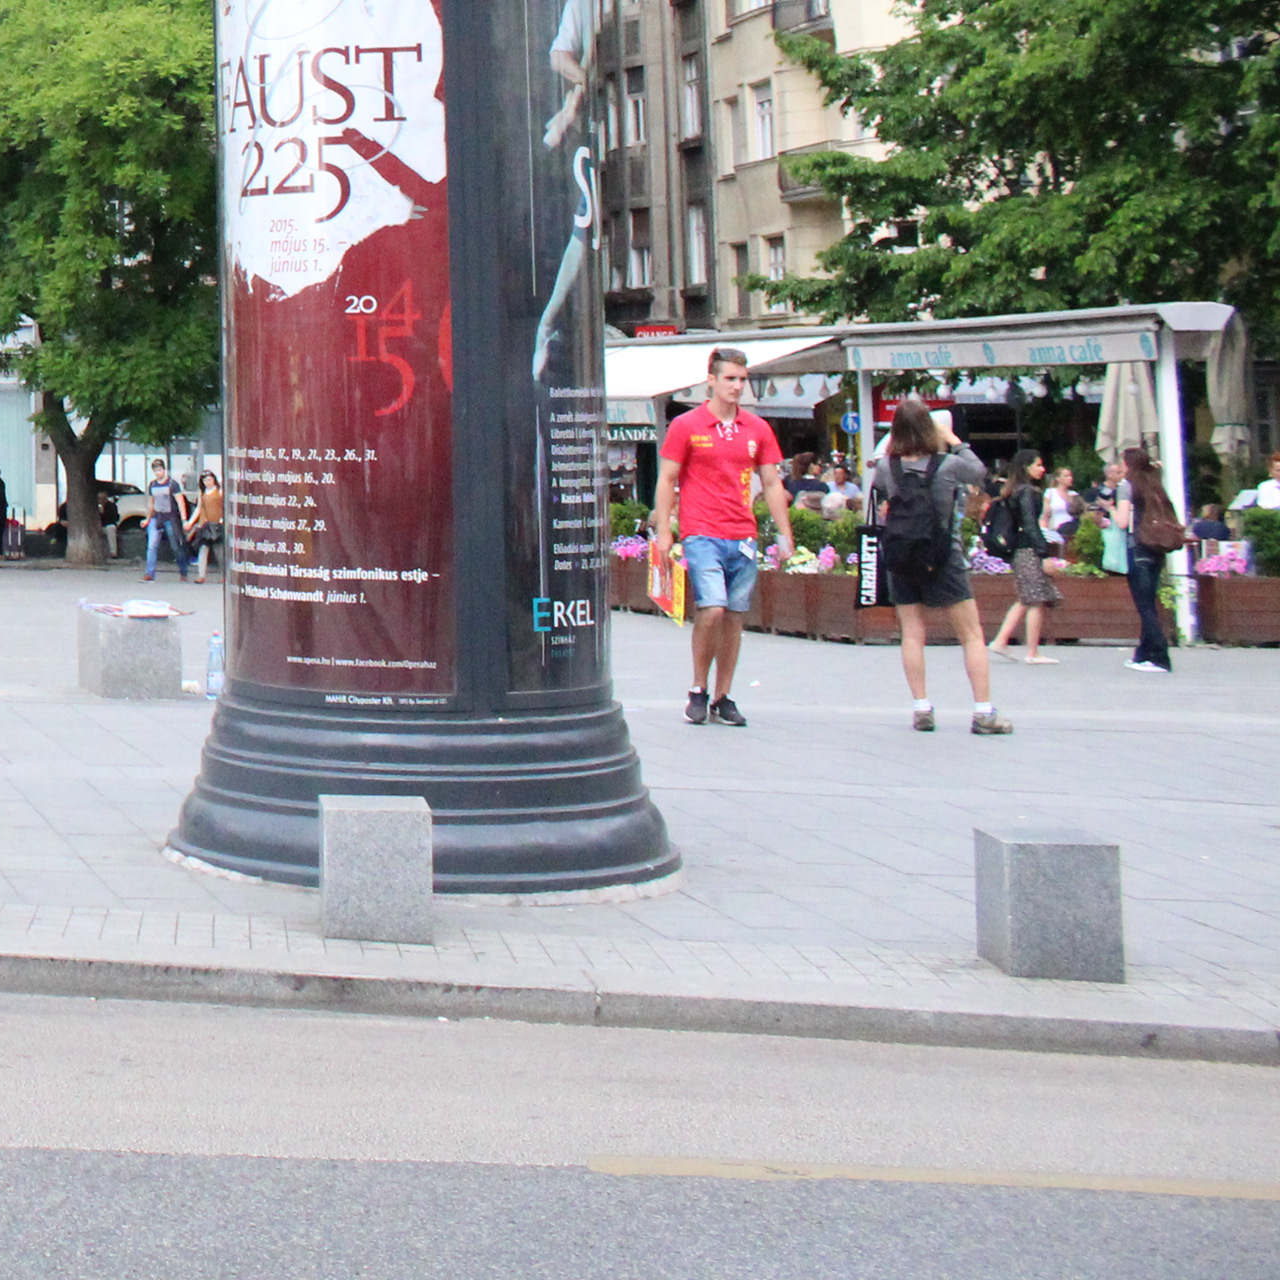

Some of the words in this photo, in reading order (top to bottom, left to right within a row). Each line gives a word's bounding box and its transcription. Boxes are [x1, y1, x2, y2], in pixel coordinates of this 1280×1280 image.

[220, 43, 423, 136] FAUST
[241, 136, 351, 224] 225
[269, 219, 298, 233] 2015.
[270, 236, 308, 253] május
[313, 238, 330, 253] 15.
[269, 256, 308, 276] június
[314, 259, 322, 272] 1.
[889, 350, 922, 368] anna
[925, 343, 954, 368] café
[1028, 345, 1066, 364] anna
[1069, 336, 1104, 363] café
[321, 473, 336, 484] 20.
[289, 564, 330, 581] Társaság
[332, 567, 398, 580] szimfonikus
[401, 569, 428, 584] estje
[860, 534, 877, 605] CARHARTT
[326, 591, 357, 604] június
[532, 597, 595, 632] ERKEL
